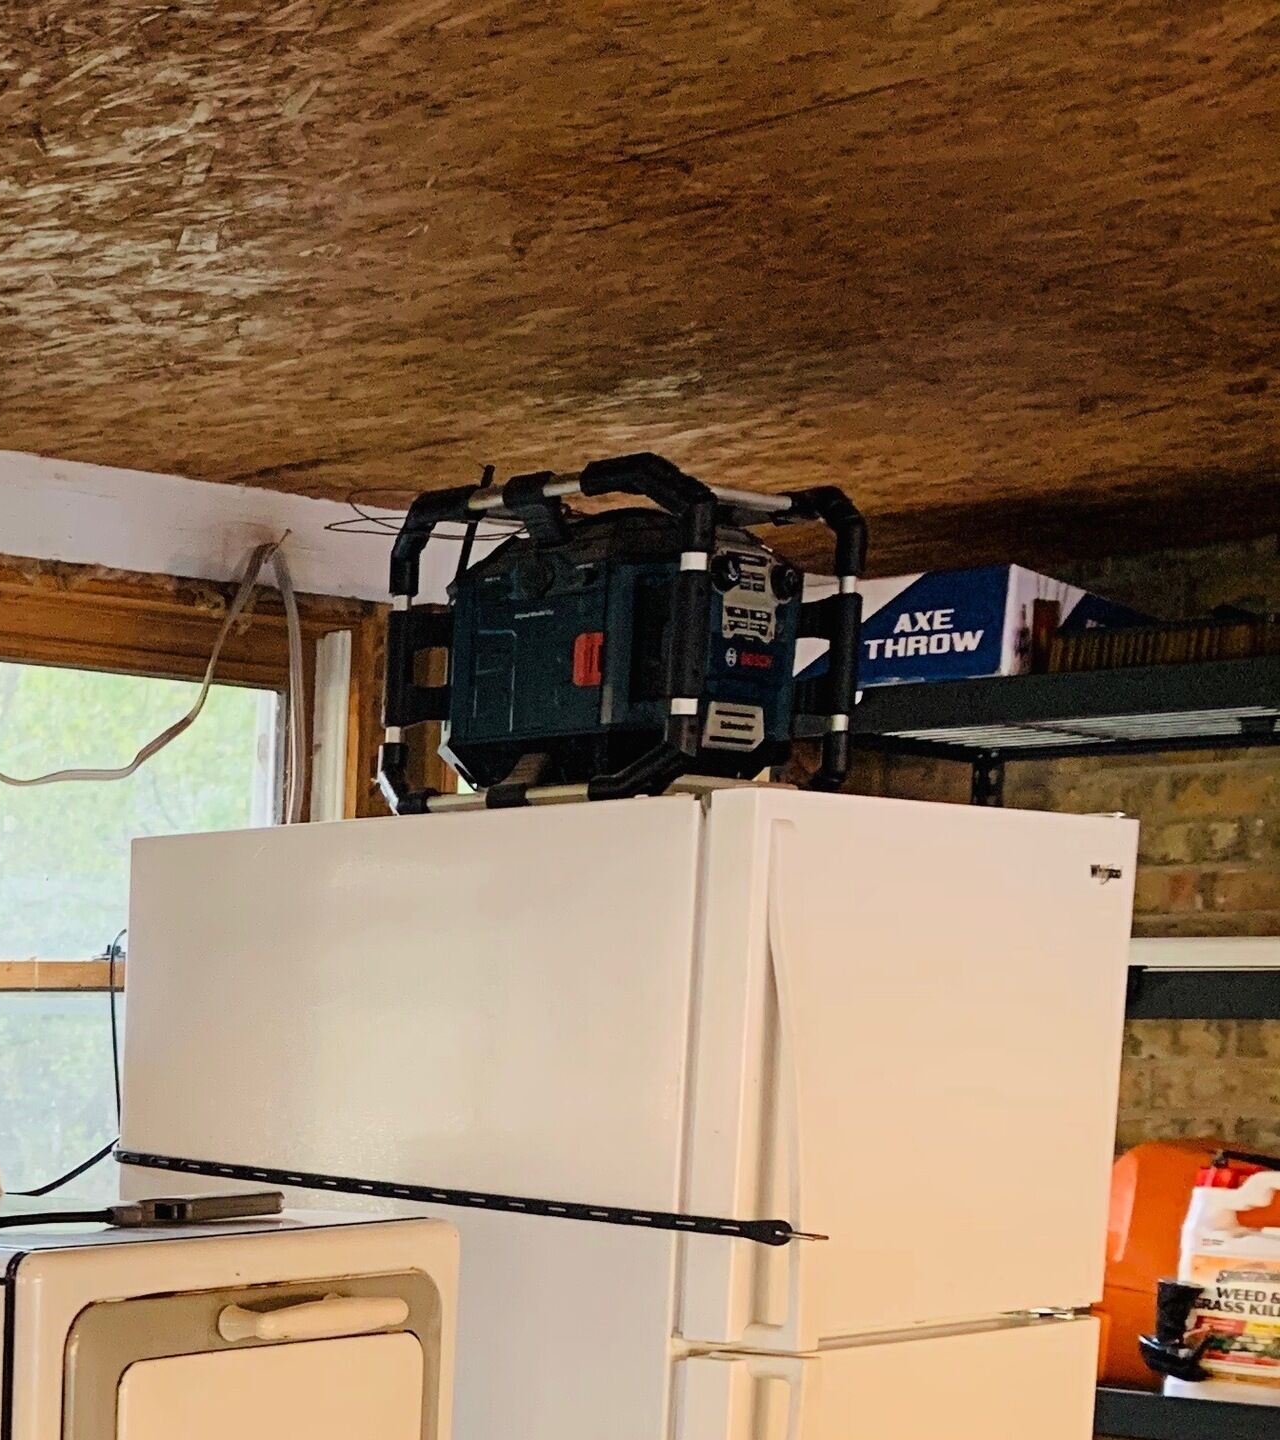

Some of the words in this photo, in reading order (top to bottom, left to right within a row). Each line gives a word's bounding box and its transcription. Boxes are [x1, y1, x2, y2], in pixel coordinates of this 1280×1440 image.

[893, 607, 955, 634] AXE
[863, 629, 984, 660] THROW
[1216, 1286, 1267, 1303] WEED
